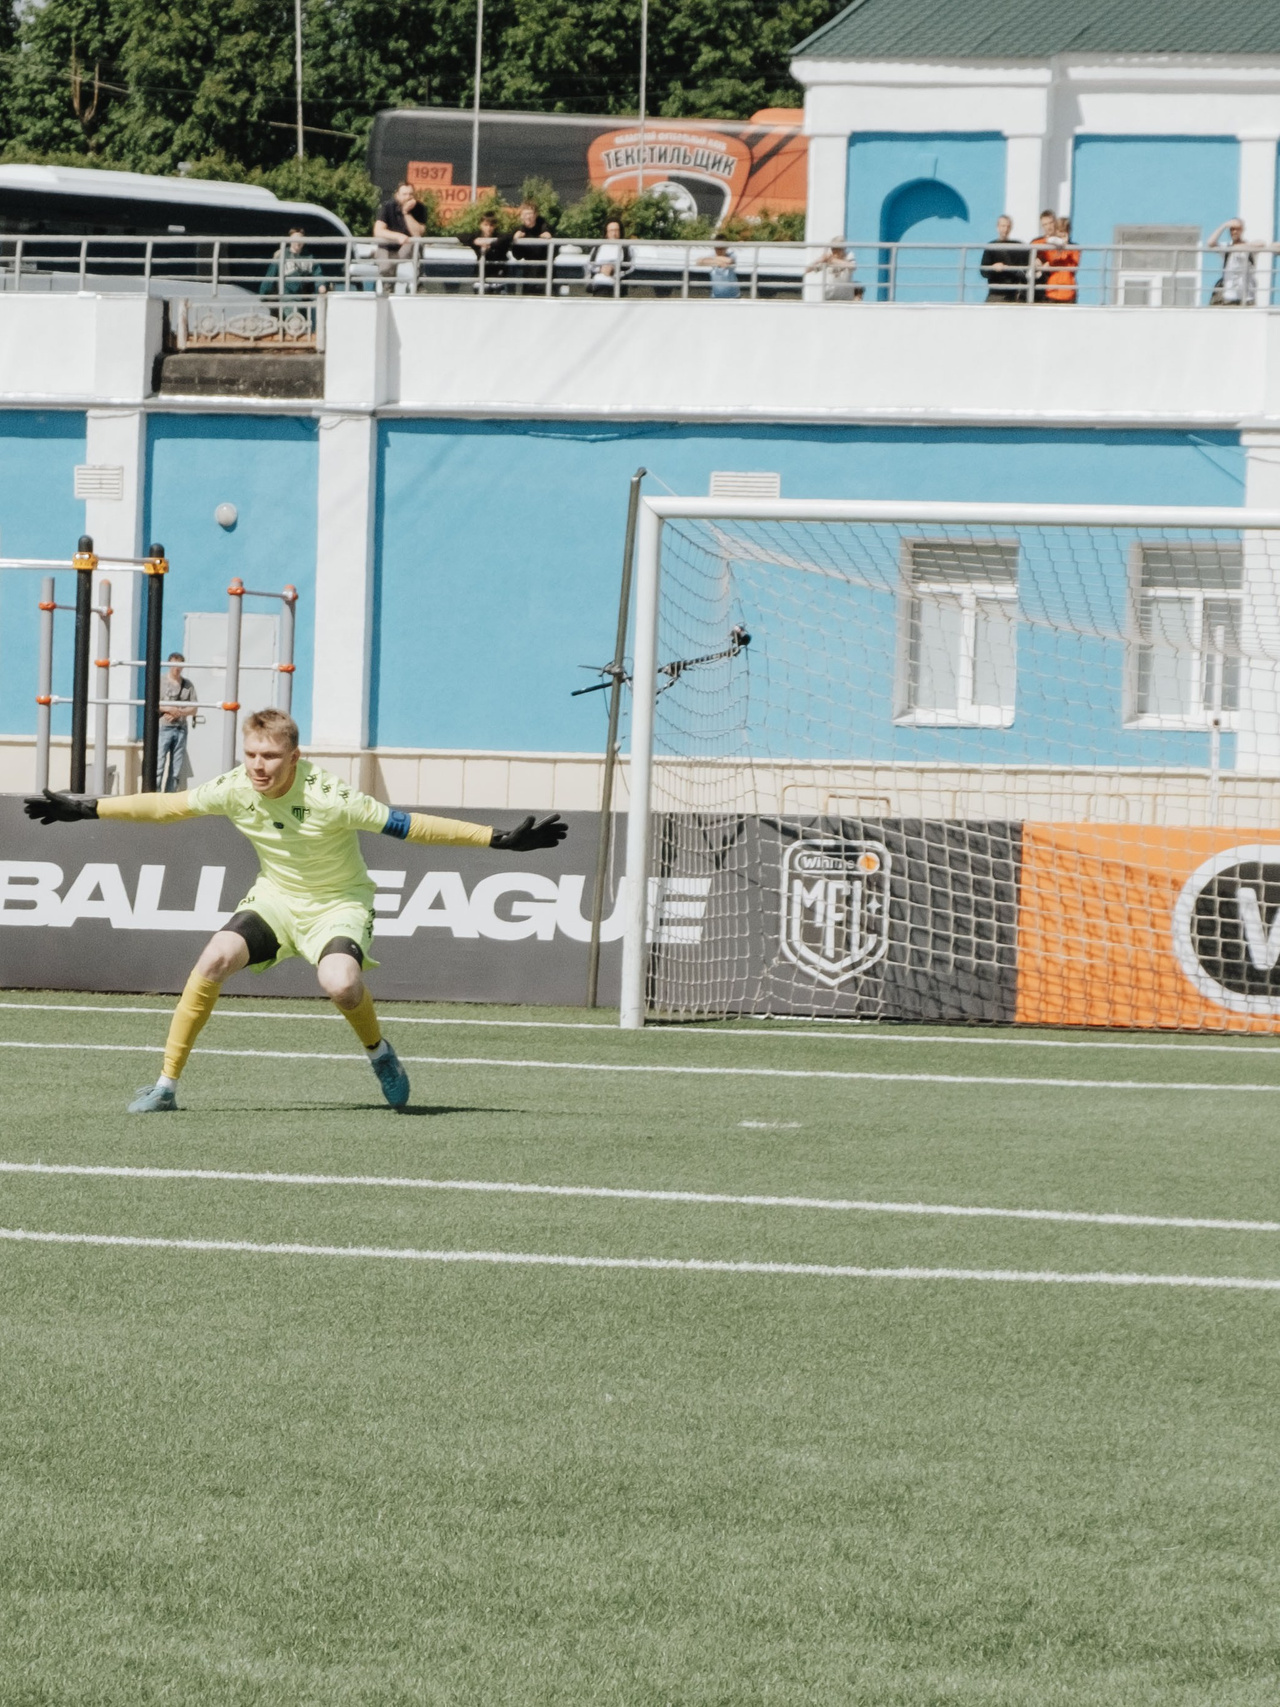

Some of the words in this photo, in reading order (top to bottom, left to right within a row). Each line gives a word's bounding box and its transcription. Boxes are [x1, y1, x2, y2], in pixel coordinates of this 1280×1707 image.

[414, 167, 448, 180] 1937
[602, 145, 737, 177] ТЕКСТИЛЬЩИК
[368, 868, 711, 944] EAGUE
